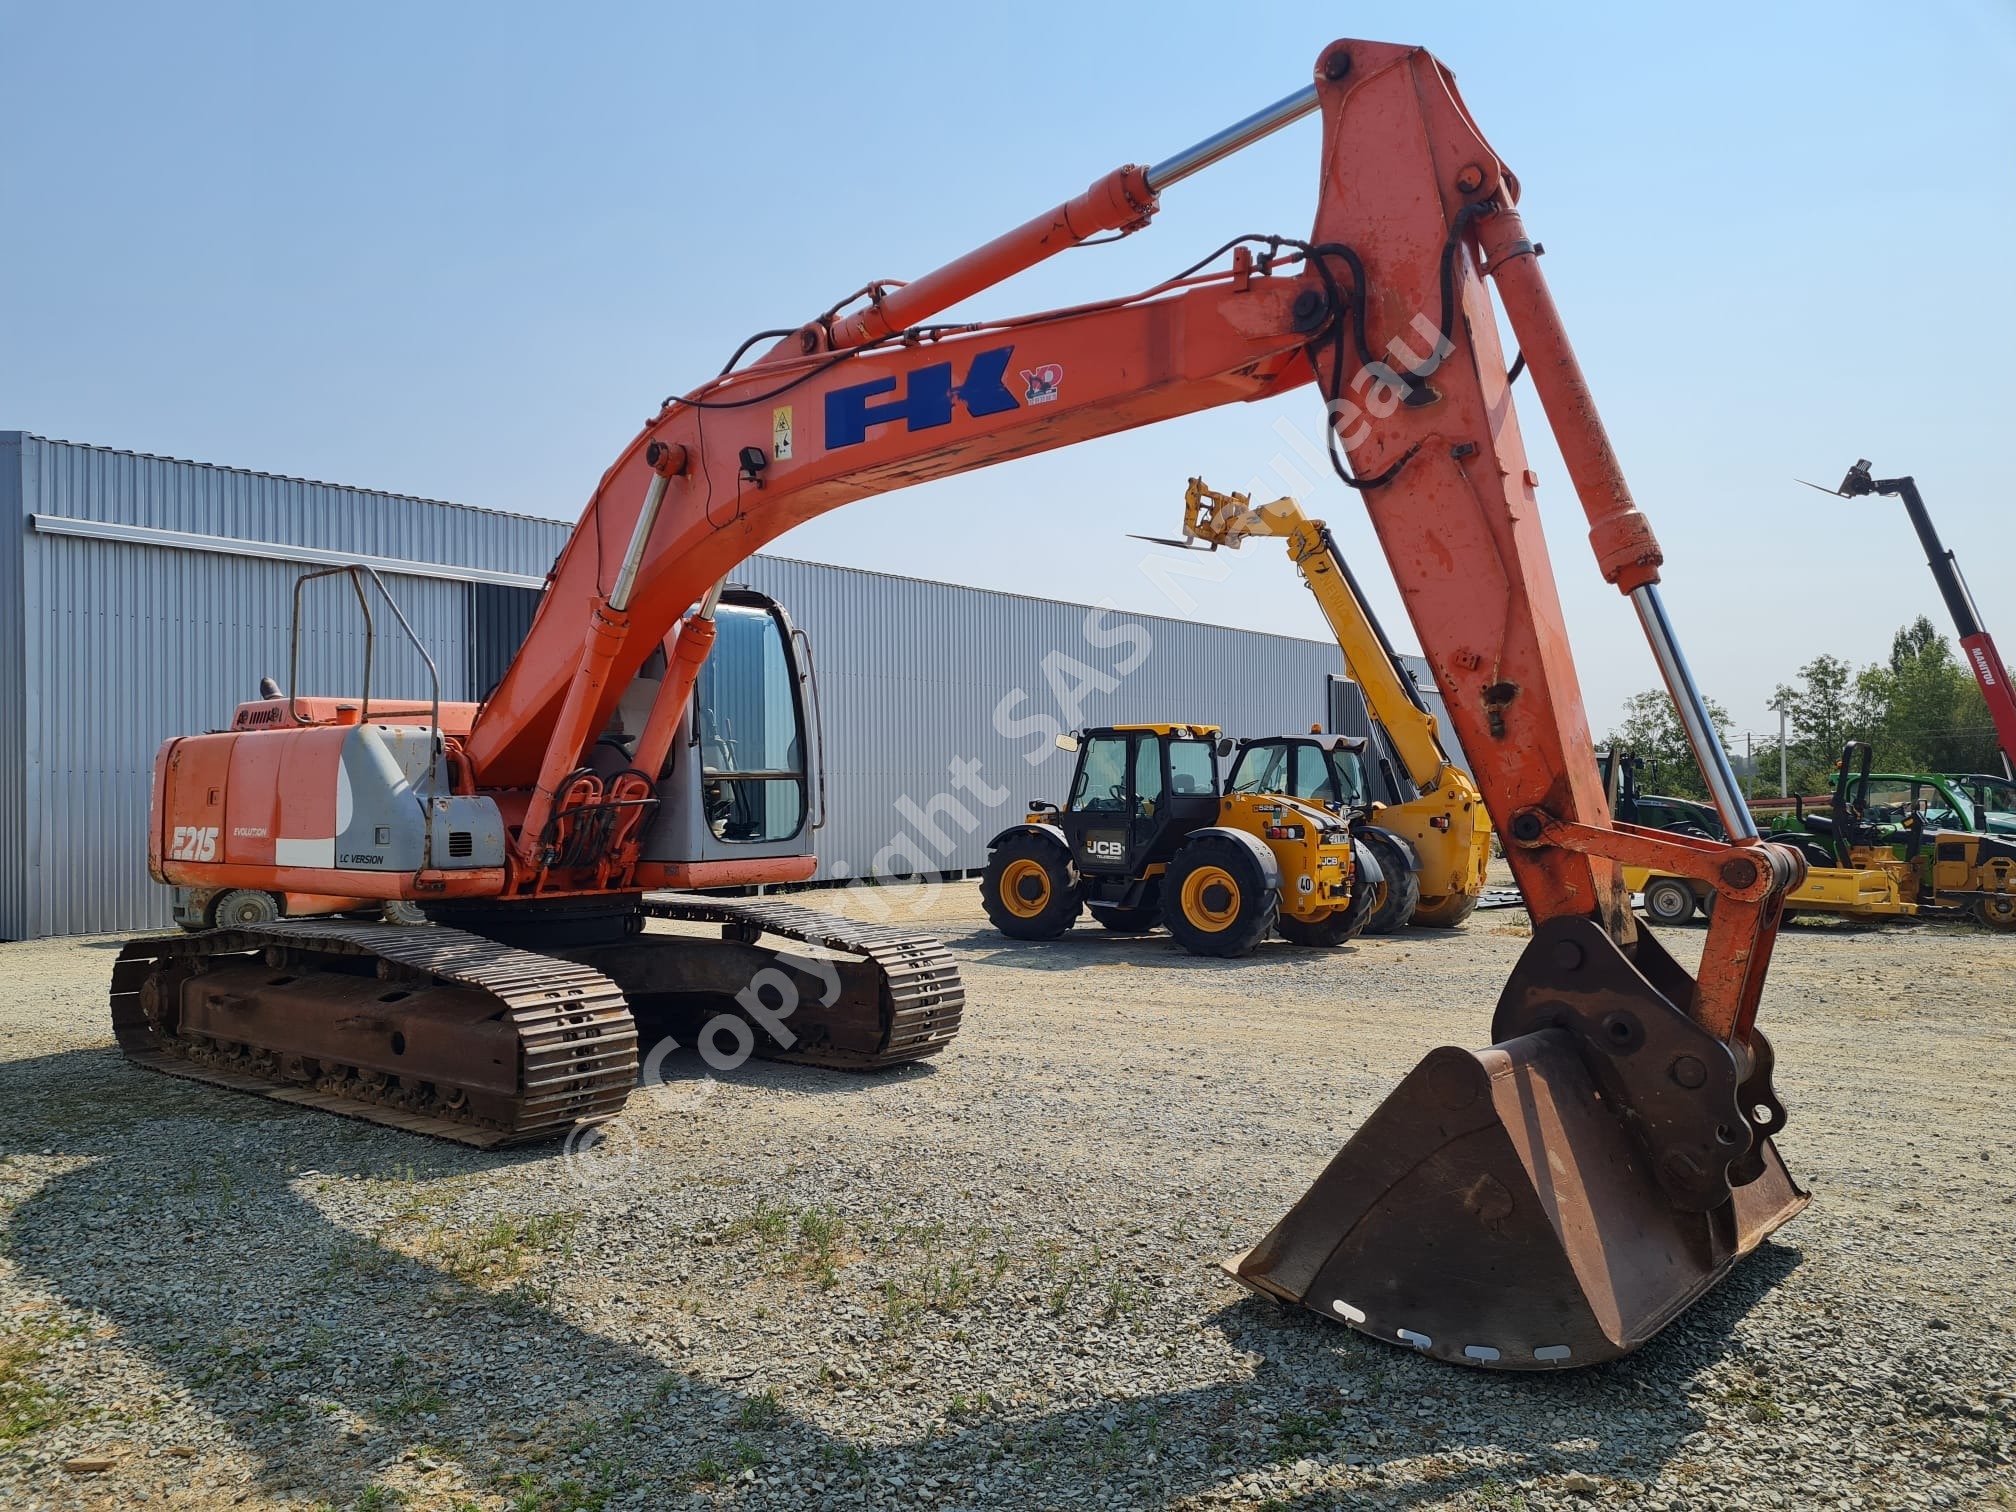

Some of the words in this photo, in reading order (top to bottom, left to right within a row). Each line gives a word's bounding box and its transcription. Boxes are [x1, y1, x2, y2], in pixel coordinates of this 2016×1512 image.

[1971, 647, 1996, 685] MANITOU
[233, 827, 267, 837] EVOLUTION
[173, 826, 219, 862] E215
[1087, 840, 1122, 855] JCB
[339, 854, 349, 863] LC
[351, 854, 384, 865] VERSION
[1321, 857, 1338, 866] JCB
[1300, 878, 1311, 891] 40
